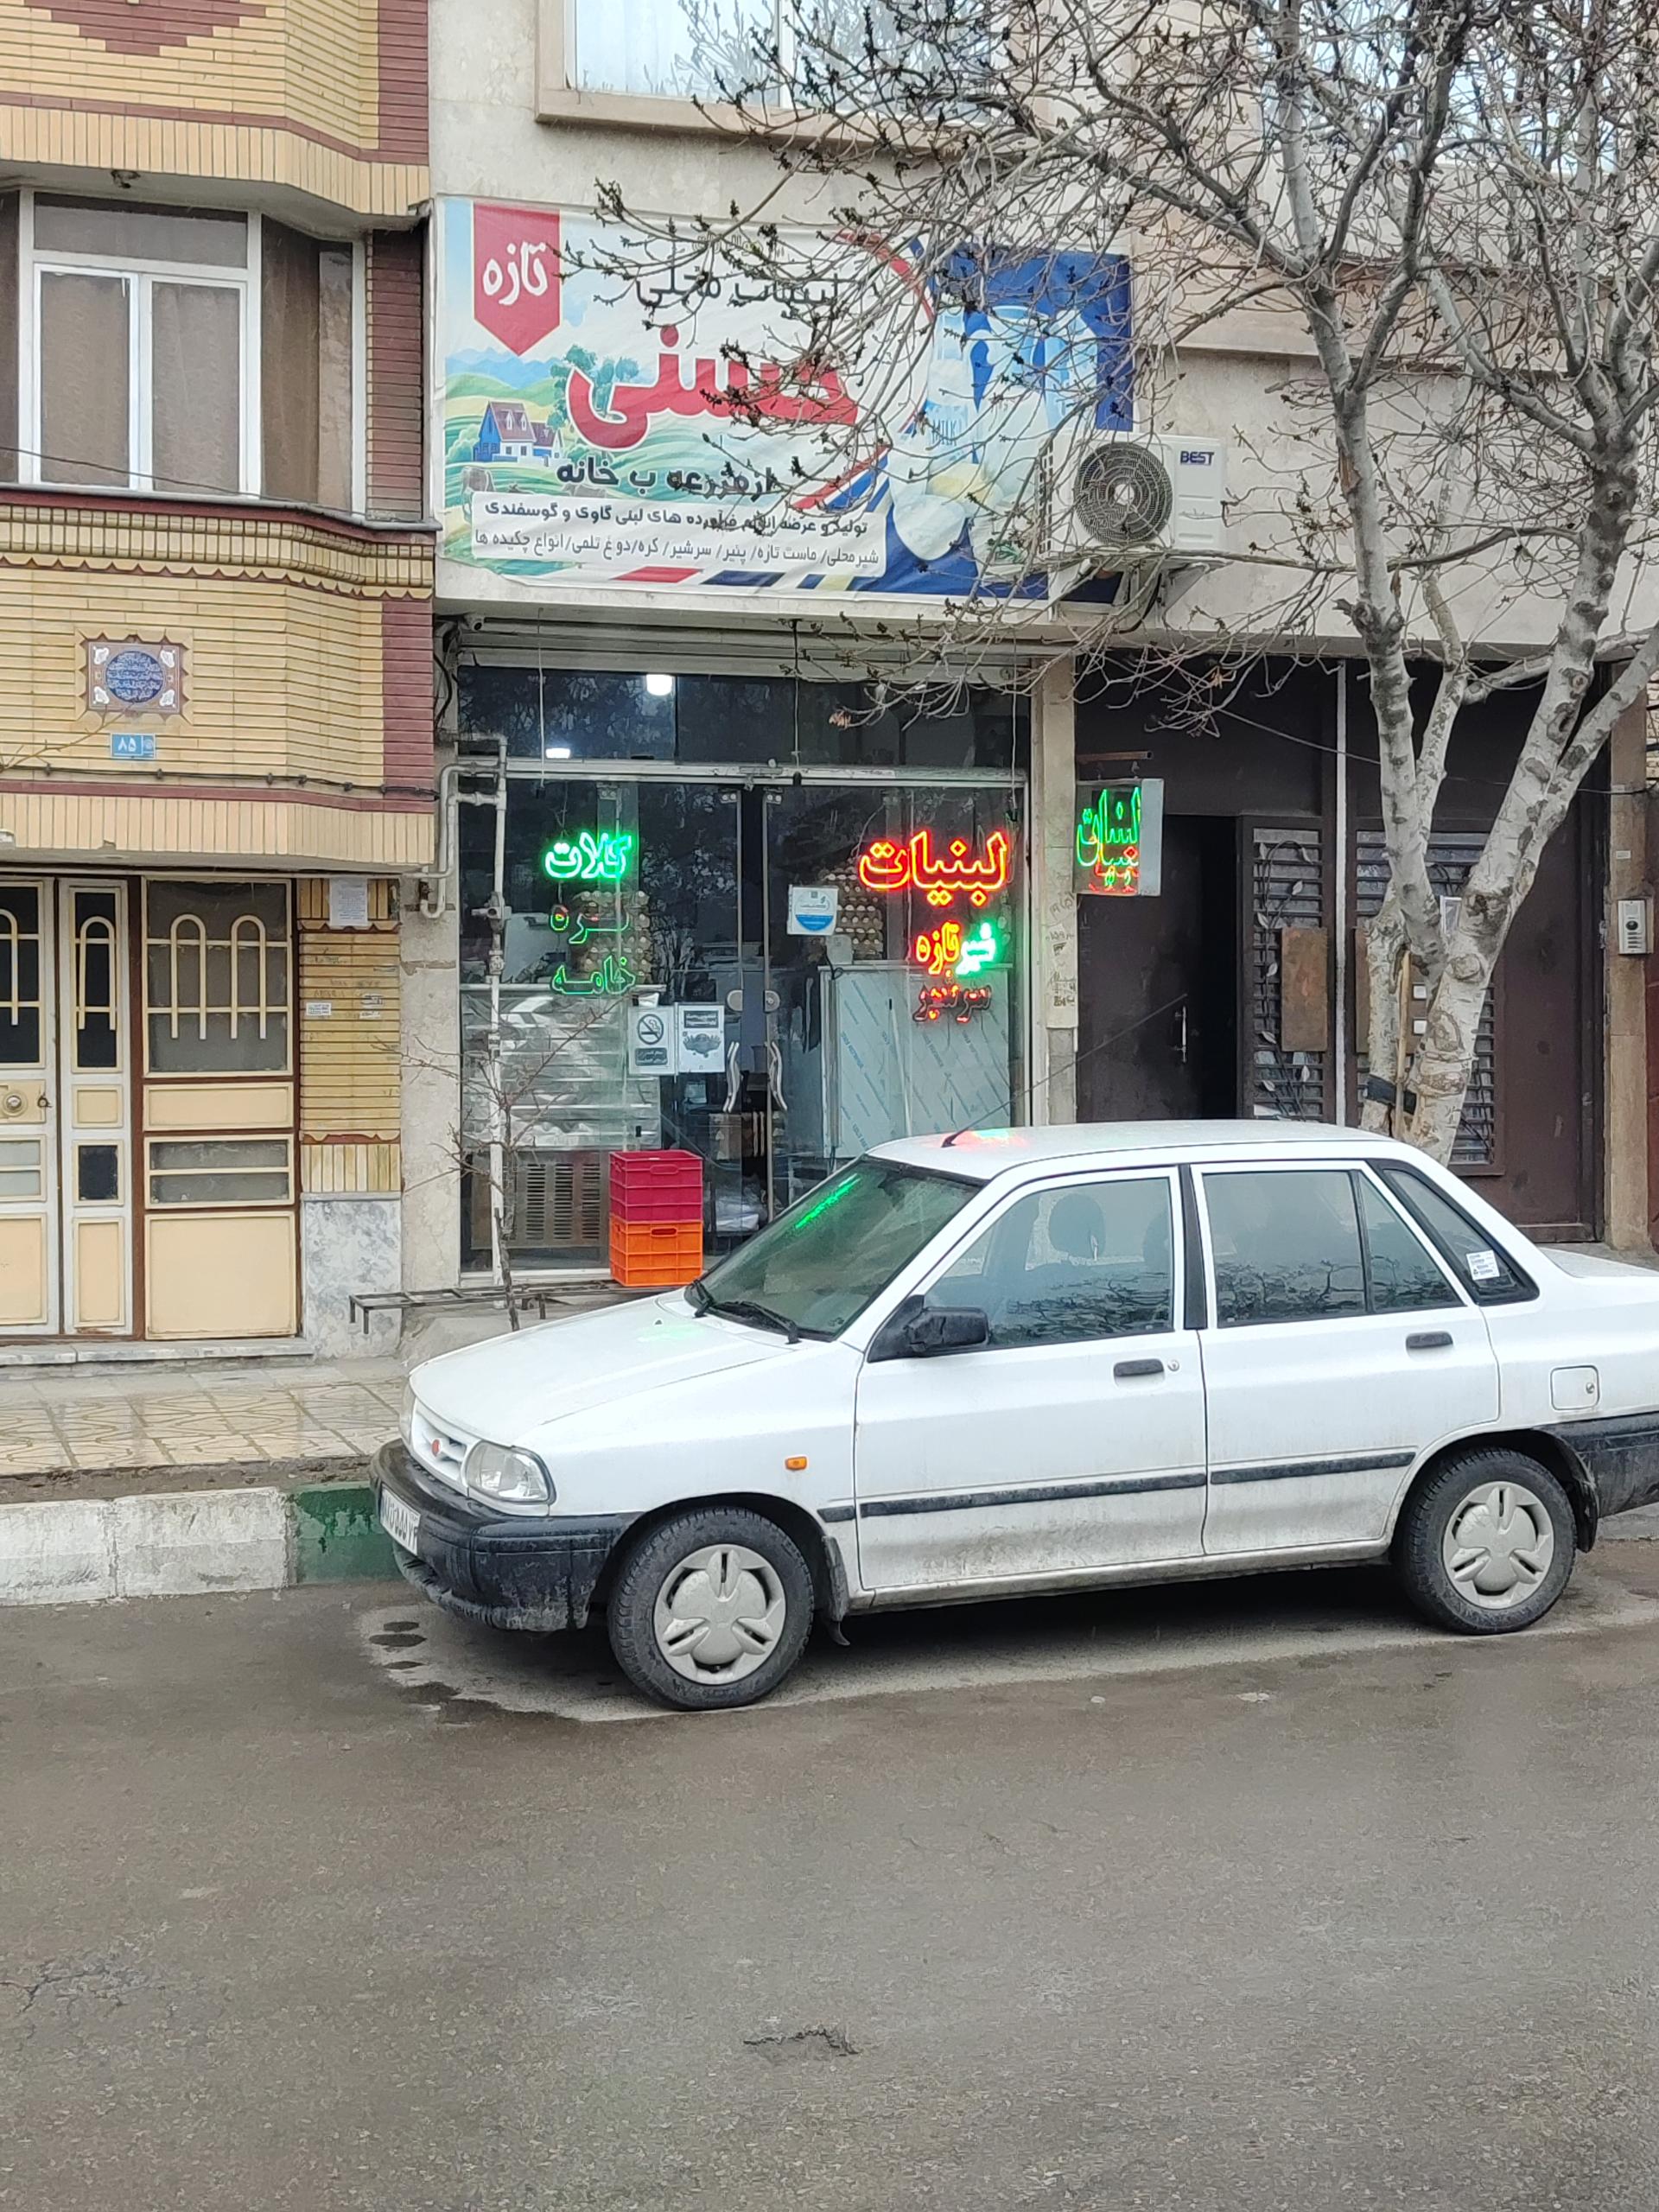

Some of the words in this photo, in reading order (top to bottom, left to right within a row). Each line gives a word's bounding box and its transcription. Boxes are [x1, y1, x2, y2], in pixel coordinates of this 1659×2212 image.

[482, 242, 548, 305] تازه
[931, 419, 958, 447] MILK
[1179, 450, 1215, 466] BEST
[556, 455, 619, 486] خانه
[628, 469, 657, 494] ب
[485, 501, 557, 518] گوسفندی
[563, 508, 570, 522] و
[575, 505, 612, 524] گاوی
[615, 508, 643, 524] لبنی
[648, 508, 681, 524] های
[779, 518, 816, 535] عرضه
[475, 529, 488, 544] ها
[493, 531, 531, 554] چکیده
[783, 546, 817, 562] ماست
[855, 550, 879, 568] شیر
[118, 737, 137, 752] ۸۵
[545, 832, 632, 879] کلات
[859, 830, 1007, 906] لبنیات
[916, 921, 960, 975] تازه
[551, 955, 635, 995] خامه
